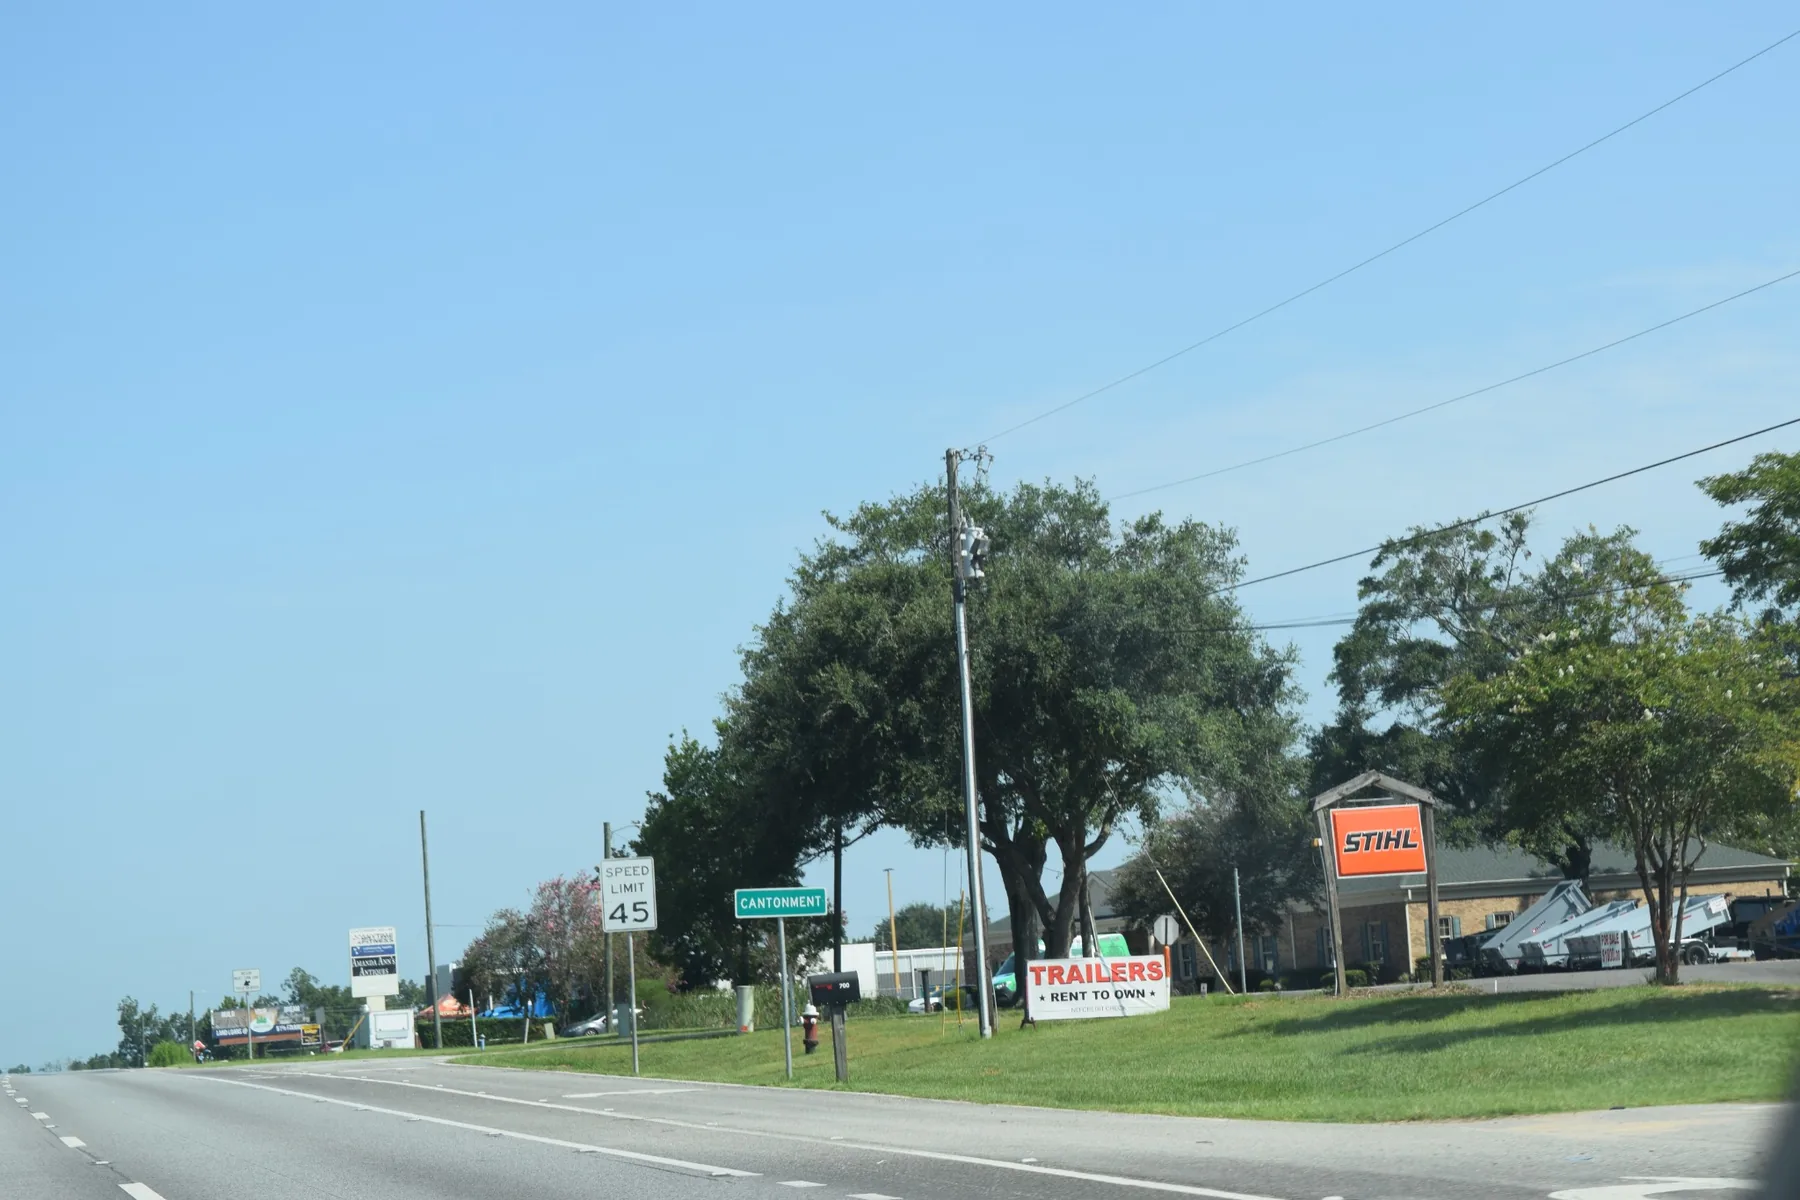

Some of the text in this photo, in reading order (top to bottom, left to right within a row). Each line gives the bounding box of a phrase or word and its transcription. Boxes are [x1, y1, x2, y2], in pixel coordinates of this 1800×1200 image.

[1343, 828, 1418, 853] STIHL
[606, 865, 650, 878] SPEED
[611, 882, 645, 894] LIMIT
[740, 895, 822, 909] CANTONMENT
[608, 901, 649, 924] 45
[1029, 961, 1163, 986] TRAILERS
[838, 982, 850, 990] 700
[1050, 989, 1145, 1002] RENT TO OWN
